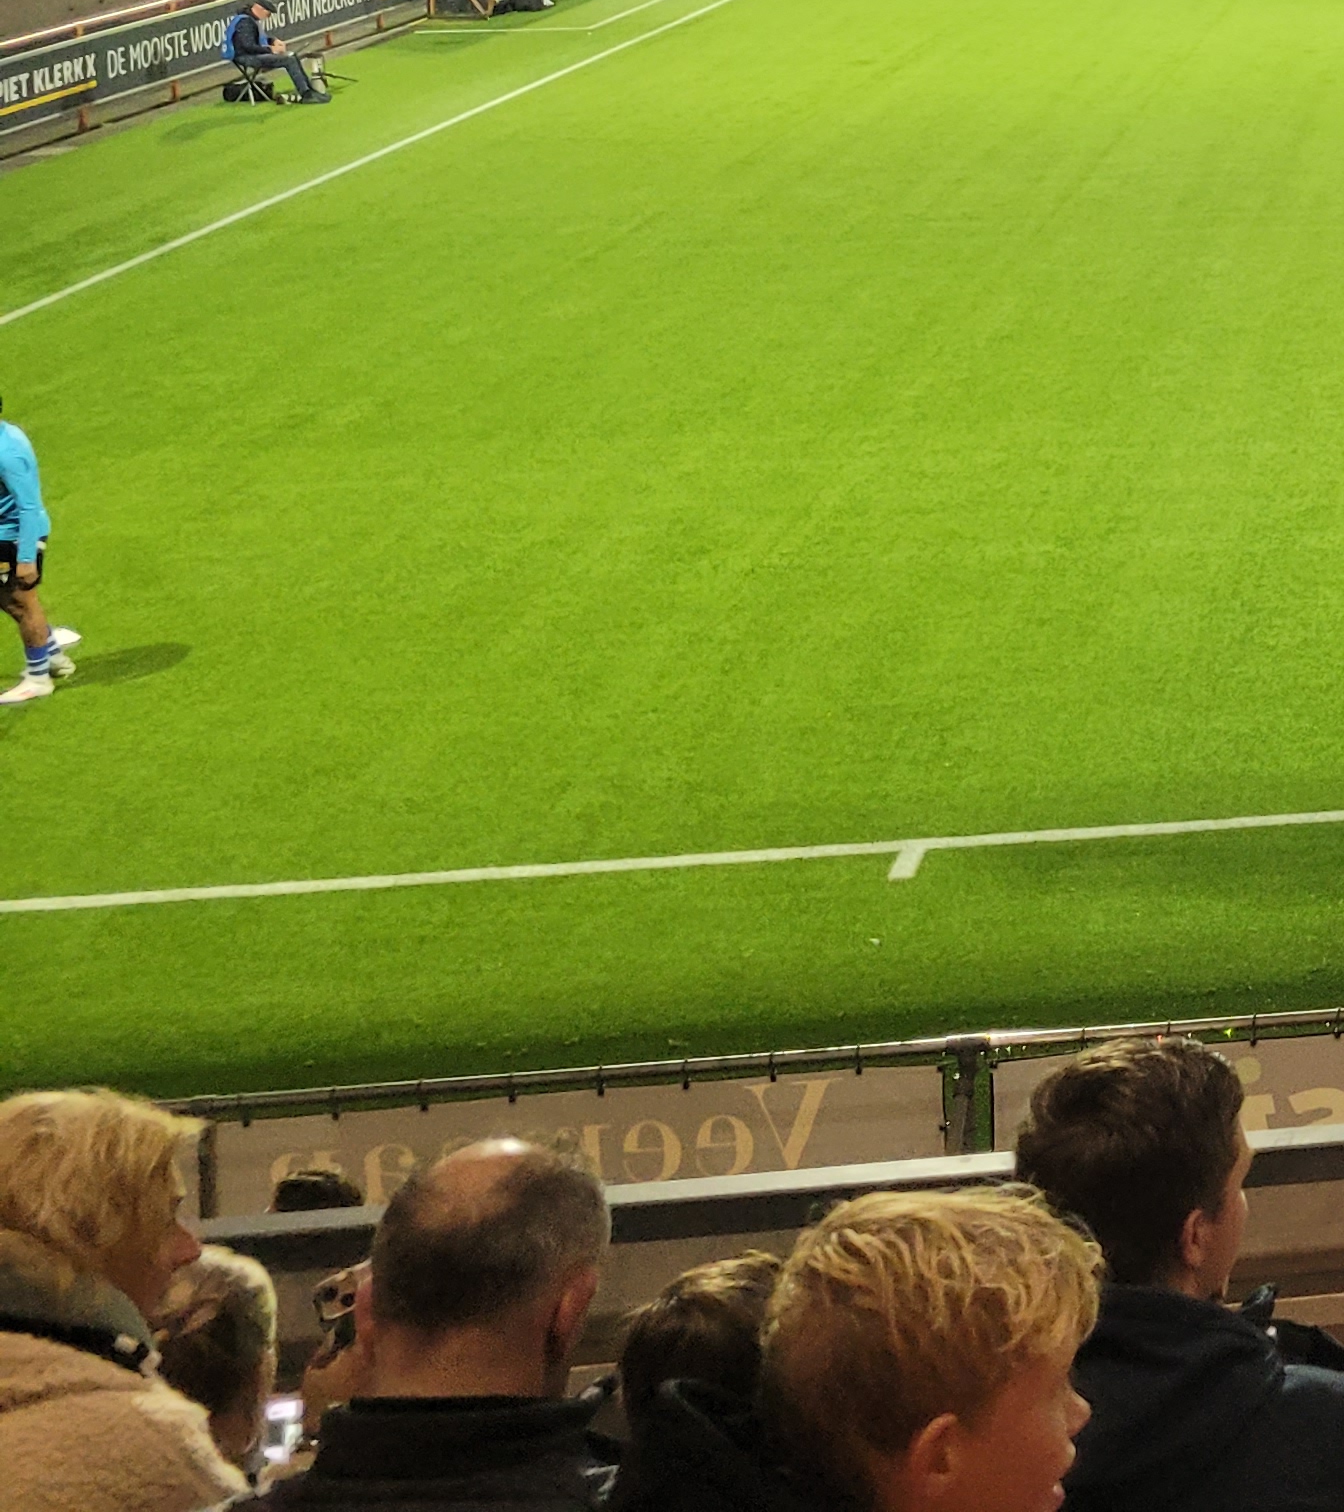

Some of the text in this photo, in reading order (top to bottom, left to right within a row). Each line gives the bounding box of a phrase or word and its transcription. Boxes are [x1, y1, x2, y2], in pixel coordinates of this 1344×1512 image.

[107, 48, 126, 79] DE
[128, 28, 189, 73] MOOISTE
[288, 0, 310, 25] VAN
[32, 53, 96, 92] KLERKX
